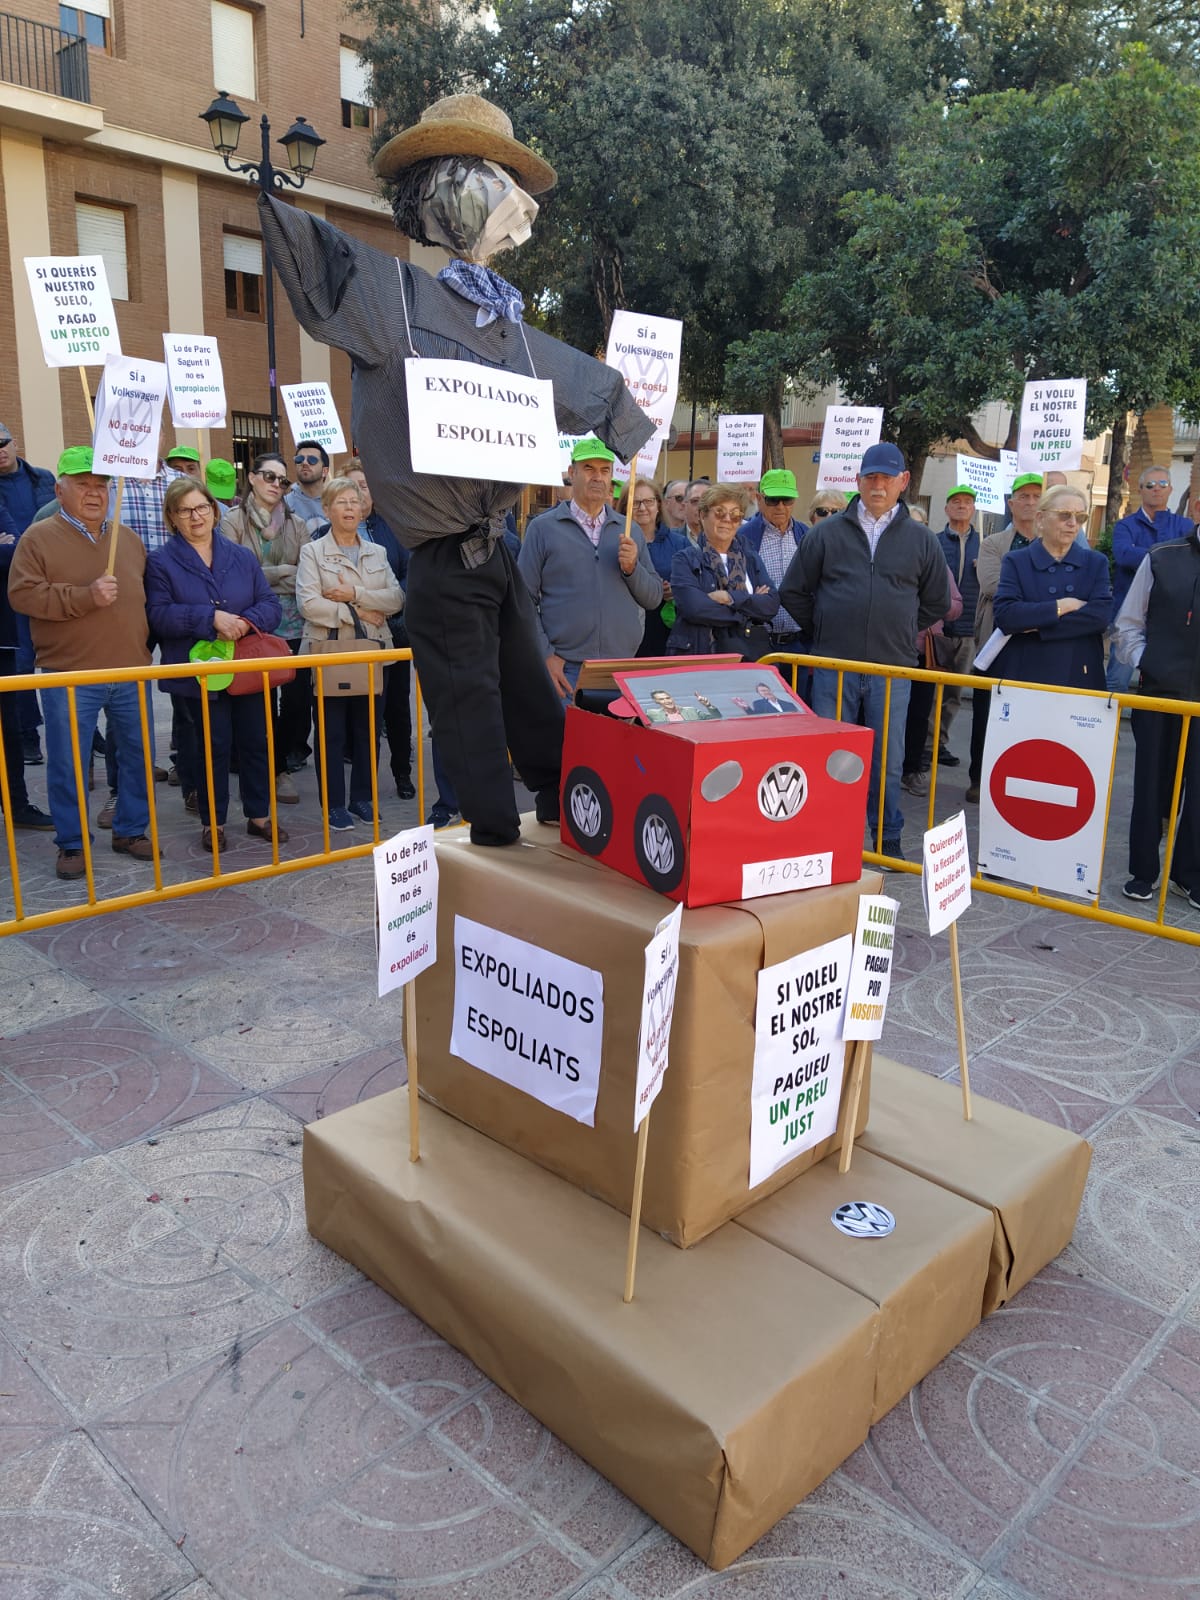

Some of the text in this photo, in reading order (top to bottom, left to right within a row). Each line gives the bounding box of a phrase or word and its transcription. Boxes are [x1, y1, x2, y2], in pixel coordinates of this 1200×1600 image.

[36, 267, 47, 279] SI
[44, 281, 95, 292] NUESTRO
[54, 295, 92, 307] SUELO,
[58, 313, 97, 325] PAGAD
[50, 327, 110, 340] UN PRECIO
[650, 331, 657, 339] a
[67, 342, 100, 353] JUSTO
[173, 345, 211, 354] Lo de Parc
[615, 342, 674, 360] Volkswagen
[177, 358, 203, 367] Sagunt
[141, 375, 146, 383] a
[424, 376, 540, 409] EXPOLIADOS
[633, 381, 639, 389] a
[642, 382, 668, 393] costa
[112, 385, 160, 403] Volkswagen
[1034, 389, 1075, 400] SI VOLEU
[294, 398, 325, 408] NUESTRO
[1030, 401, 1077, 411] EL NOSTRE
[304, 419, 328, 429] PAGAD
[834, 415, 874, 424] Lo de Parc
[108, 419, 151, 433] NO a costa
[835, 427, 862, 436] Sagunt
[300, 427, 337, 439] UN PRECIO
[436, 422, 537, 449] ESPOLIATS
[1033, 429, 1071, 438] PAGUEU
[119, 438, 137, 448] dels
[1031, 440, 1071, 450] UN PREU
[103, 453, 149, 466] agricultors
[1039, 452, 1061, 462] JUST
[965, 467, 995, 477] NUESTRO
[930, 836, 954, 854] Quieren
[386, 840, 428, 864] Lo de Parc
[933, 863, 939, 873] la
[940, 853, 955, 869] fiesta
[391, 864, 421, 885] Sagunt
[400, 891, 410, 903] no
[387, 898, 432, 932] expropiació
[390, 941, 429, 973] expoliació
[462, 944, 595, 1024] EXPOLIADOS
[777, 962, 838, 1005] SI VOLEU
[867, 980, 881, 997] POR
[771, 988, 842, 1036] EL NOSTRE
[467, 1006, 580, 1082] ESPOLIATS
[773, 1053, 830, 1096] PAGUEU
[769, 1077, 829, 1125] UN PREU
[783, 1111, 815, 1145] JUST
